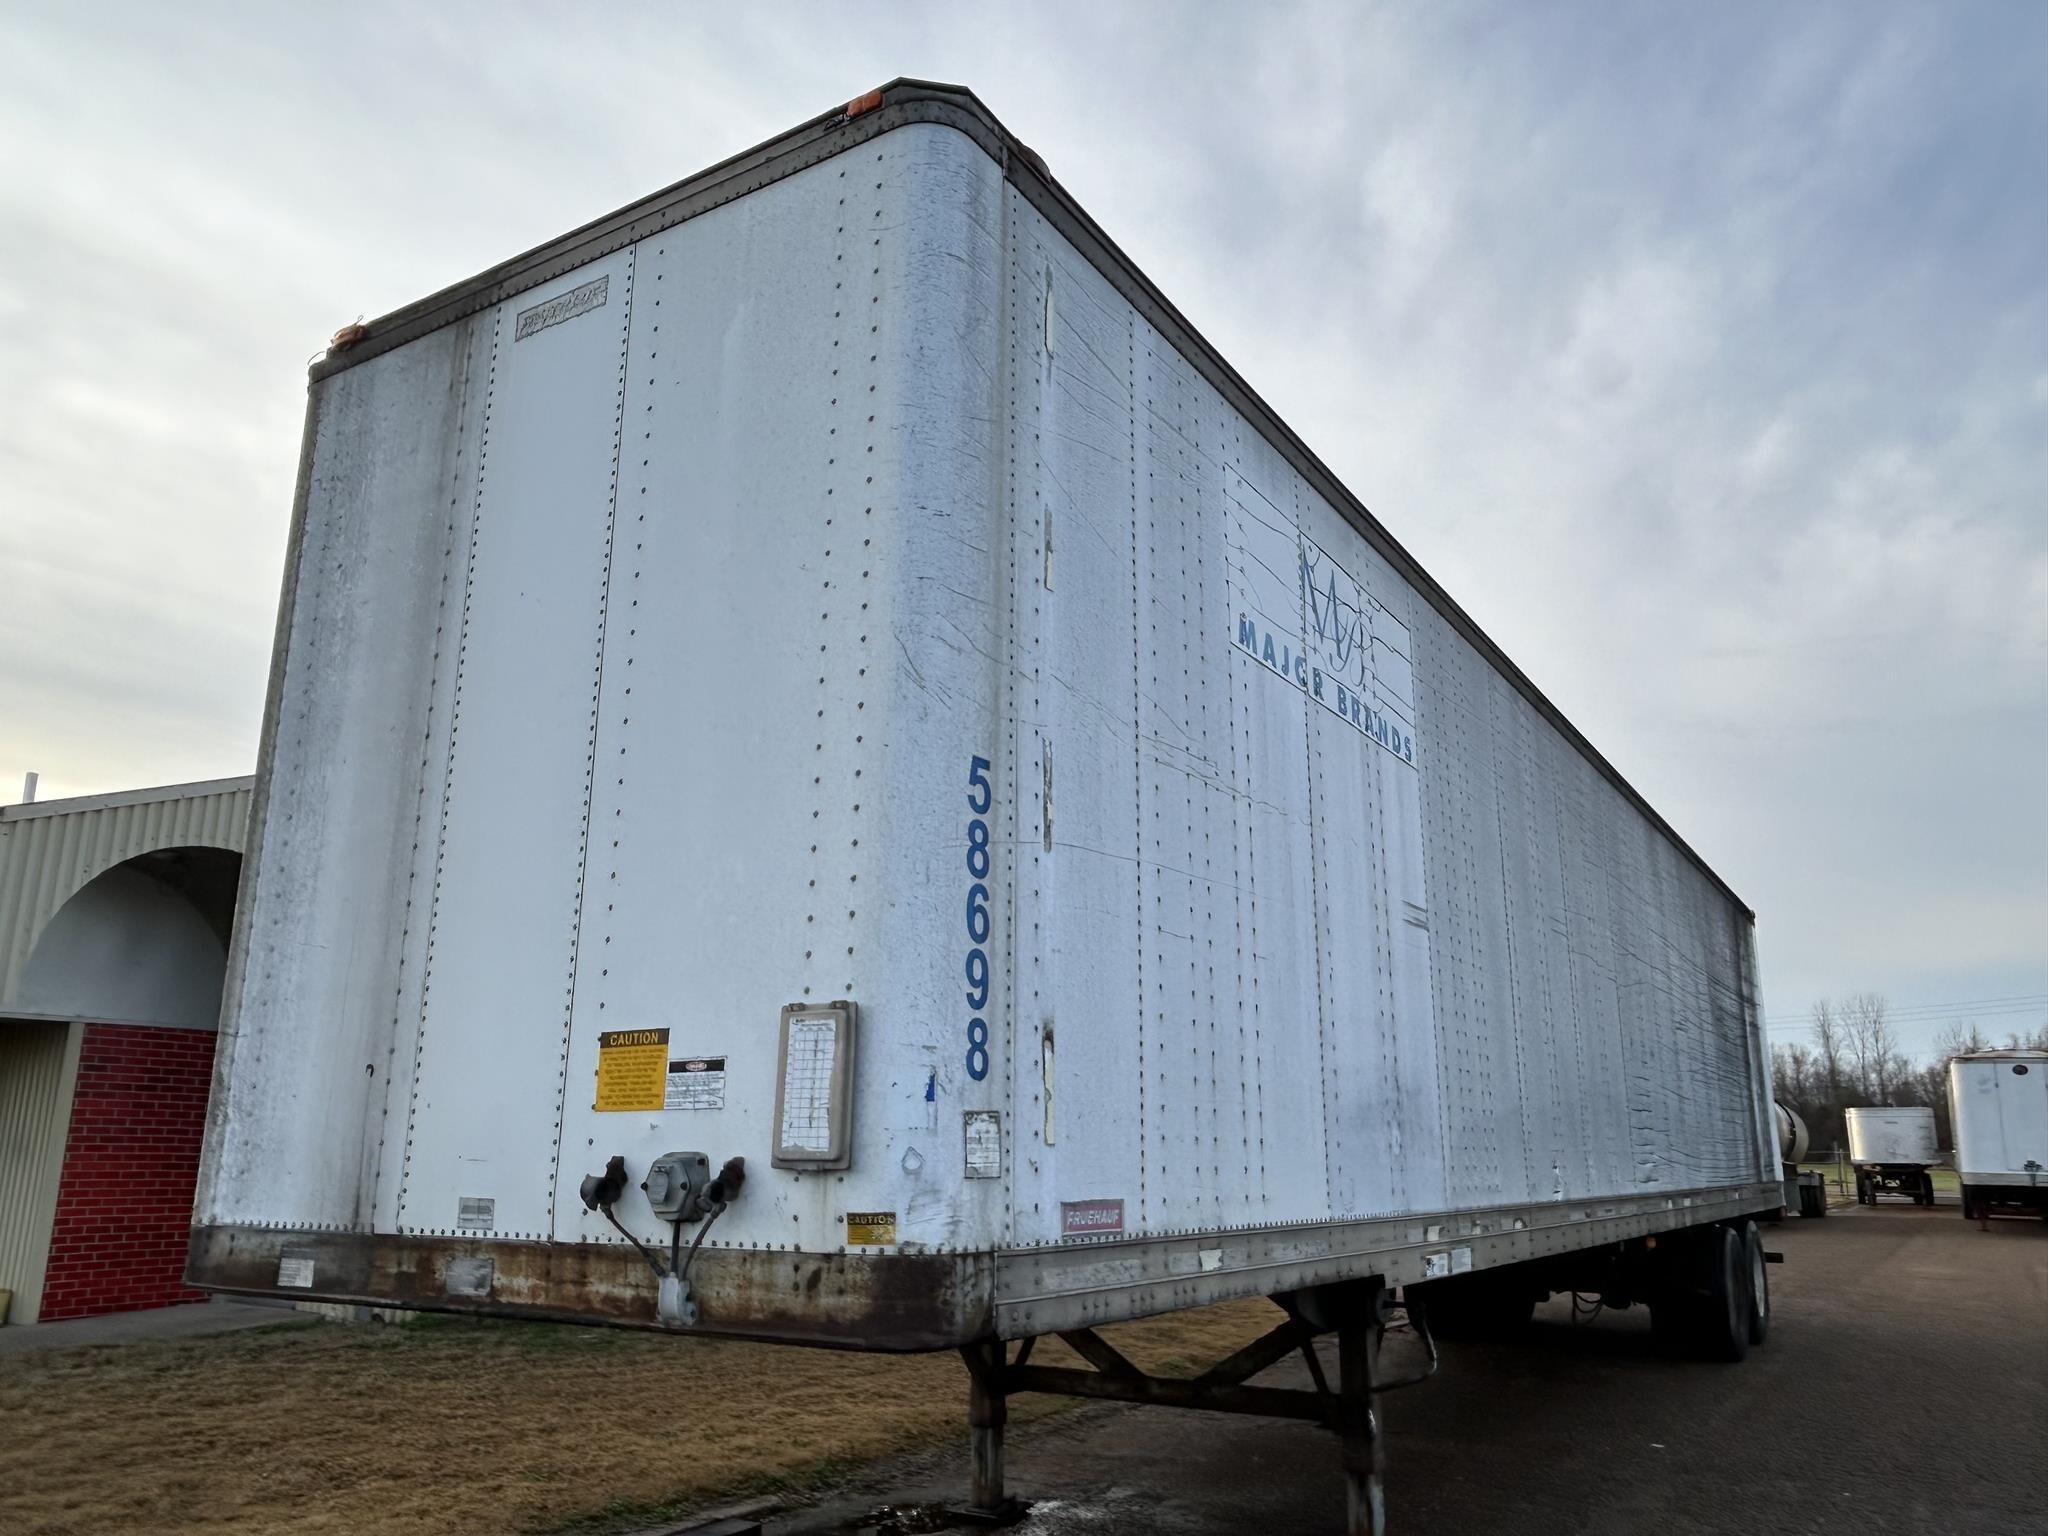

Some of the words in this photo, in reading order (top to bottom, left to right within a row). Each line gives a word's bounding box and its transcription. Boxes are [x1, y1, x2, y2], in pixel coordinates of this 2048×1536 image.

[1238, 613, 1324, 701] MAJOR
[1337, 684, 1412, 762] BRANDS
[966, 755, 991, 1081] 58698
[610, 1031, 659, 1046] CAUTION
